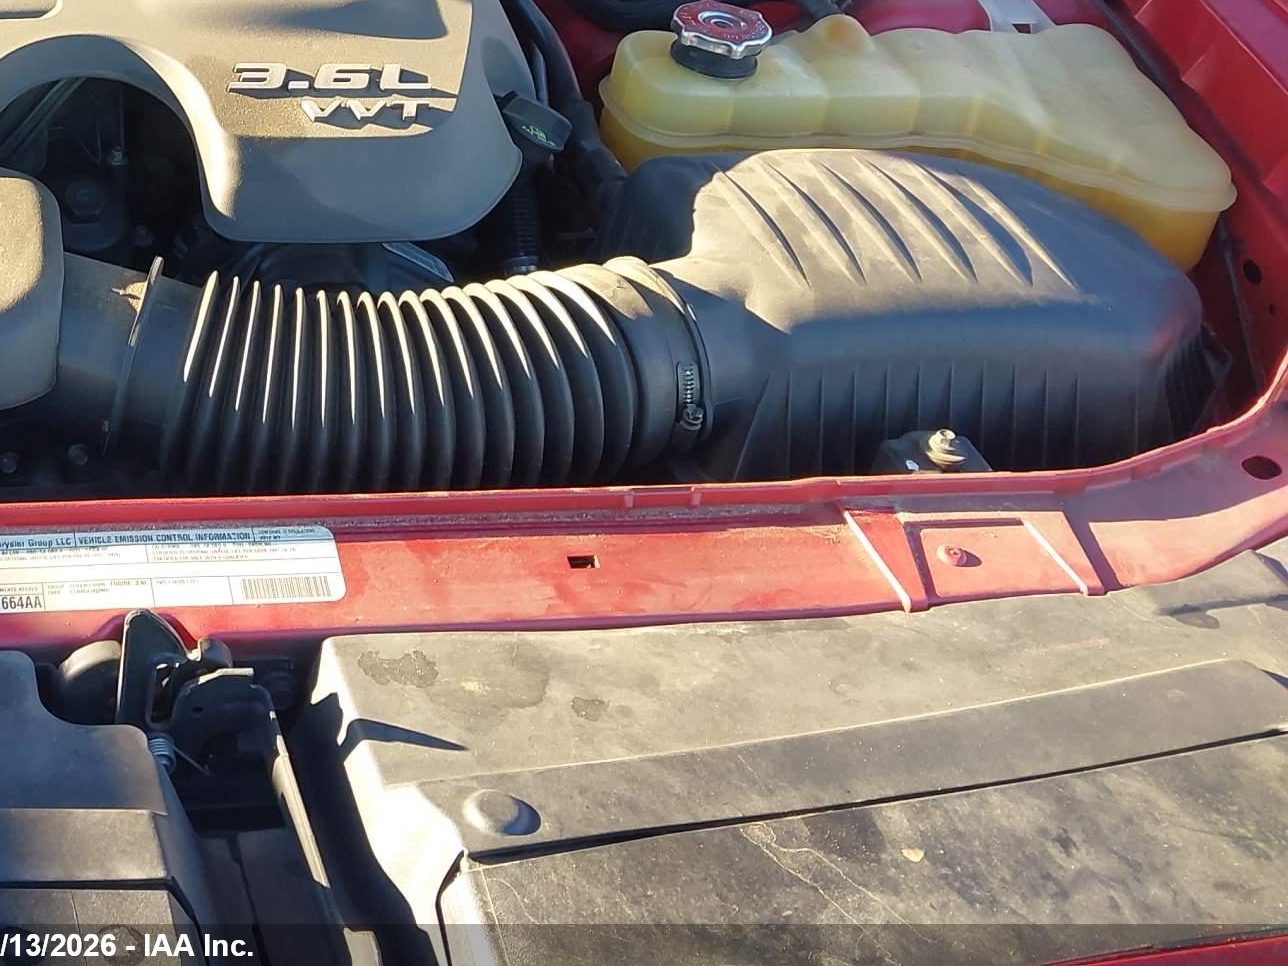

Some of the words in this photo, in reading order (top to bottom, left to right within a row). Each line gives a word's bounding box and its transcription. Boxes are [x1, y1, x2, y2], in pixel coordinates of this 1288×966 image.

[226, 62, 433, 93] 3.6L
[300, 98, 433, 123] VVT
[27, 538, 53, 549] Group
[55, 537, 72, 546] LLC
[78, 536, 112, 545] VEHICLE
[114, 534, 153, 543] EMISSION
[156, 533, 193, 542] CONTROL
[195, 532, 251, 541] INFORMATION
[1, 595, 42, 610] 664AA
